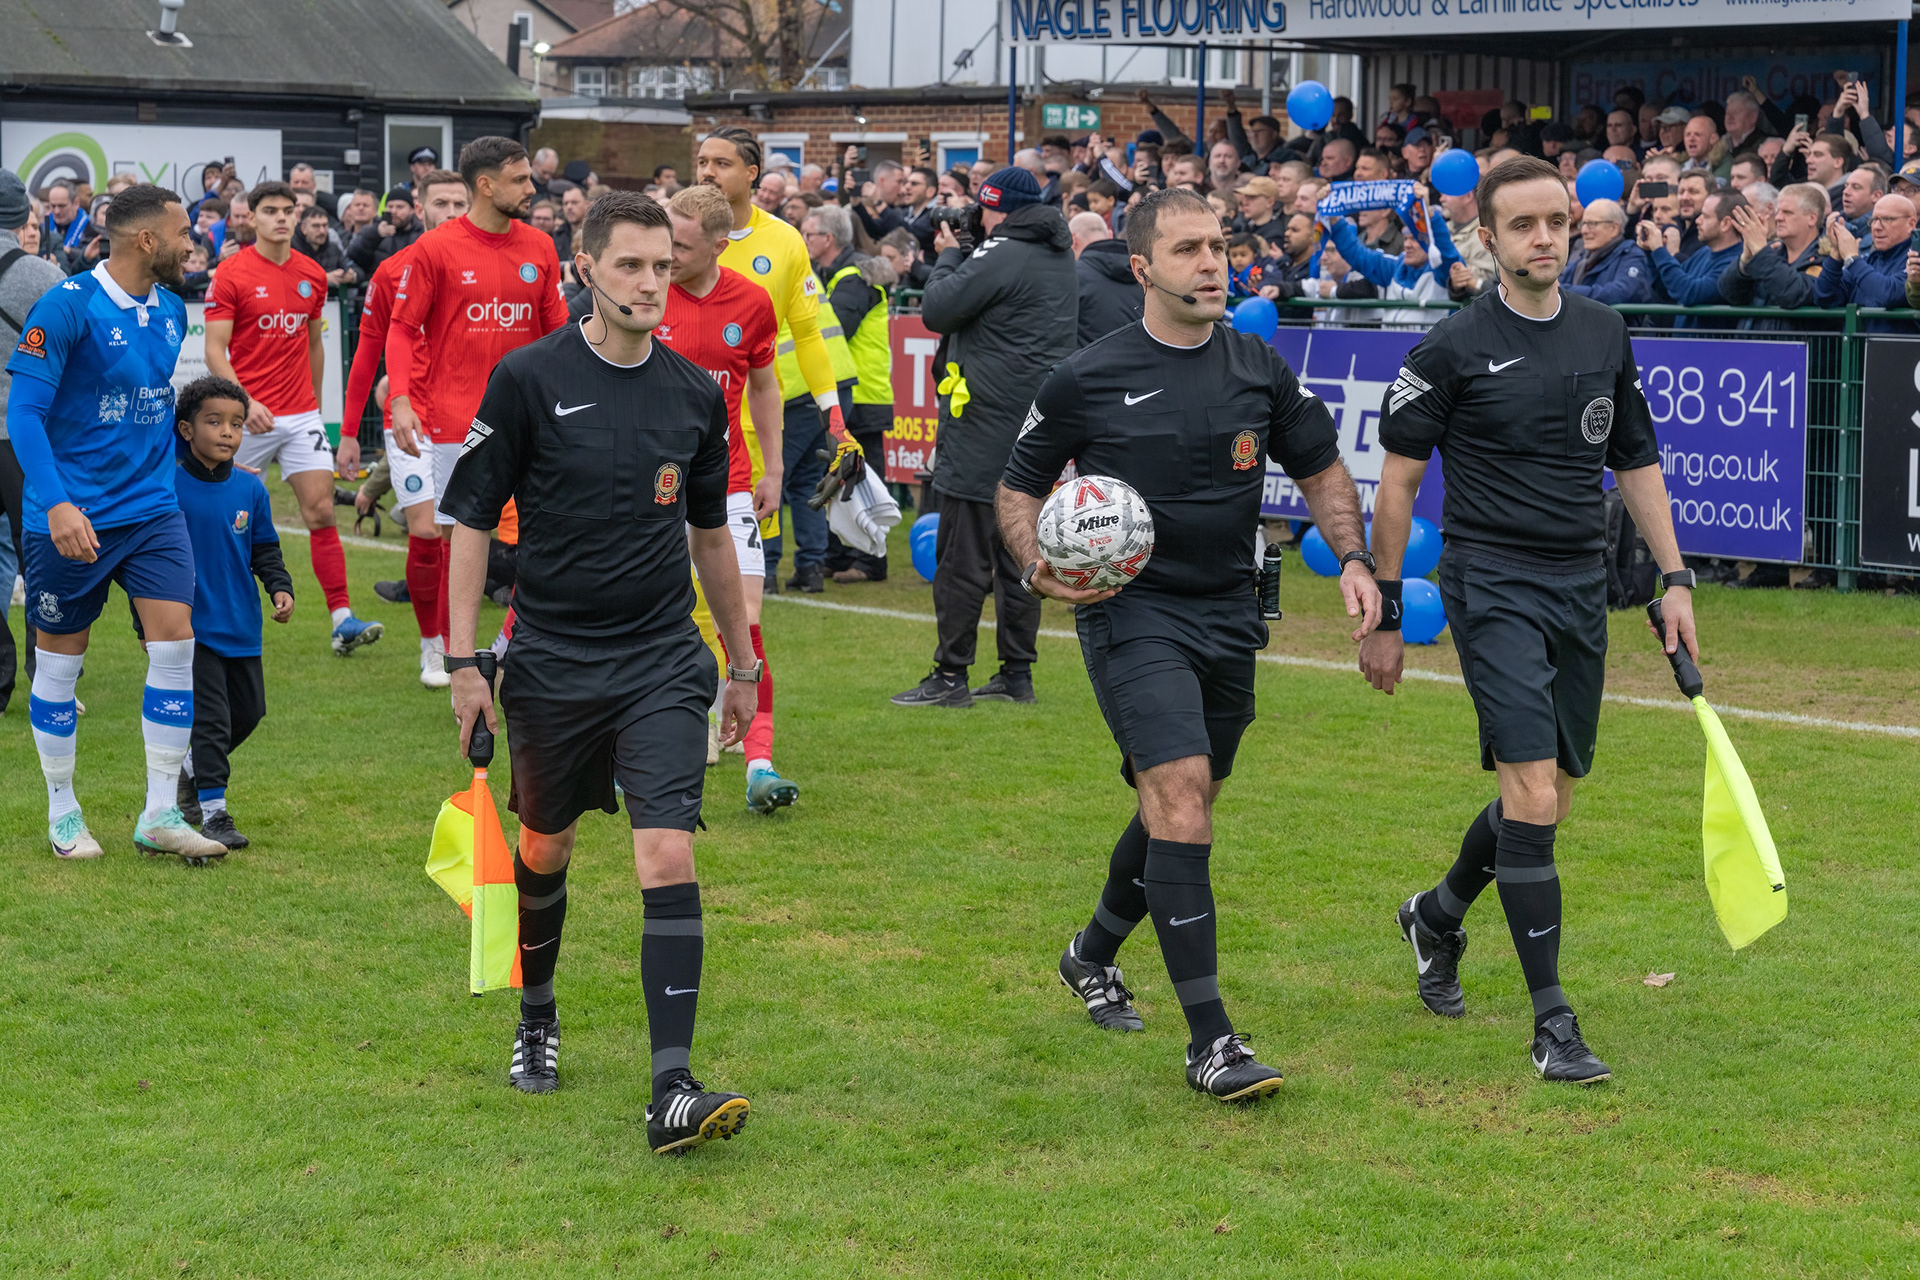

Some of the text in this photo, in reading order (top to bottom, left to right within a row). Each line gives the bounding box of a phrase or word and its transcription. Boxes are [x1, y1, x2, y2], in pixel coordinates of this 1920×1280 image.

[1010, 0, 1287, 40] NAGLE FLOORING
[1309, 0, 1421, 19] Hardwood
[258, 309, 309, 334] origin
[467, 297, 532, 328] origin
[904, 337, 940, 408] T
[1718, 368, 1795, 429] 341
[884, 416, 923, 442] 805
[887, 445, 925, 470] a fast
[1075, 515, 1120, 533] Mitre
[43, 718, 74, 727] KELME
[153, 706, 189, 717] KELME
